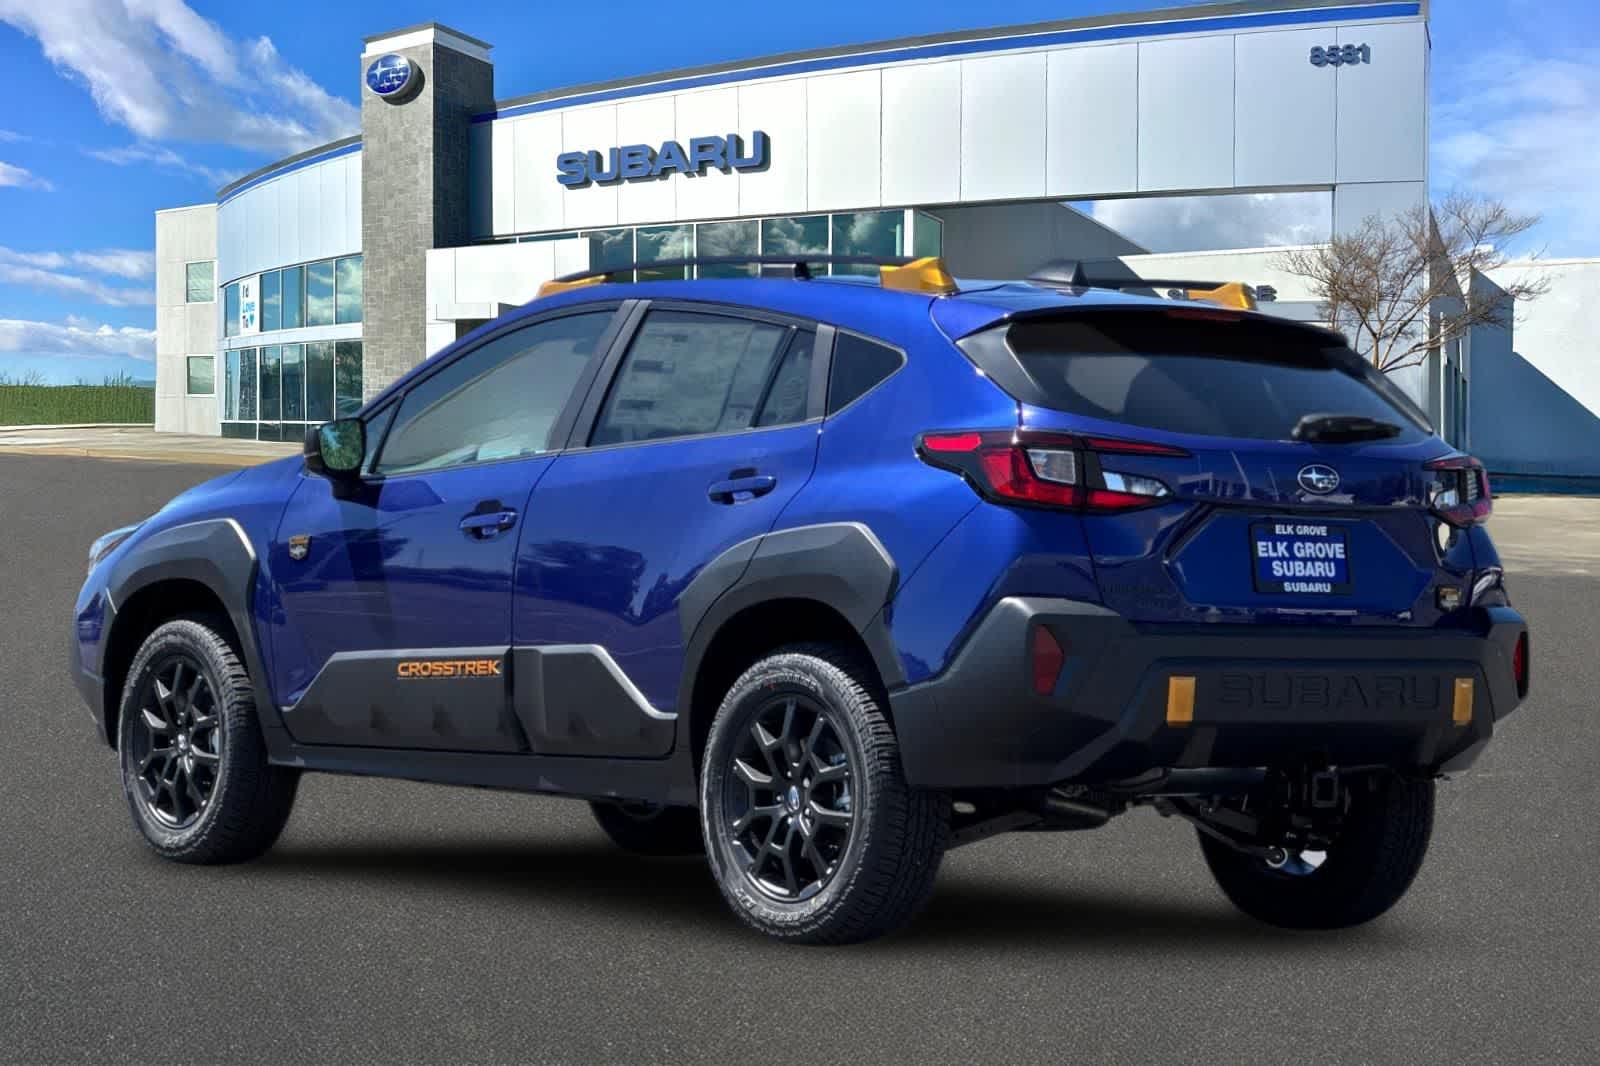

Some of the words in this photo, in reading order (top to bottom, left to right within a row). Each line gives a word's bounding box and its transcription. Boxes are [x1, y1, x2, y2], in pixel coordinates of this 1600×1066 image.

[1310, 44, 1370, 67] 8581
[556, 130, 771, 190] SUBARU
[1275, 524, 1294, 535] ELK
[1296, 525, 1327, 536] GROVE
[1257, 541, 1290, 557] ELK
[1293, 542, 1345, 559] GROVE
[1272, 560, 1336, 577] SUBARU
[1284, 582, 1331, 593] SUBARU
[397, 660, 502, 677] CROSSTREK
[1217, 672, 1442, 711] SUBARU
